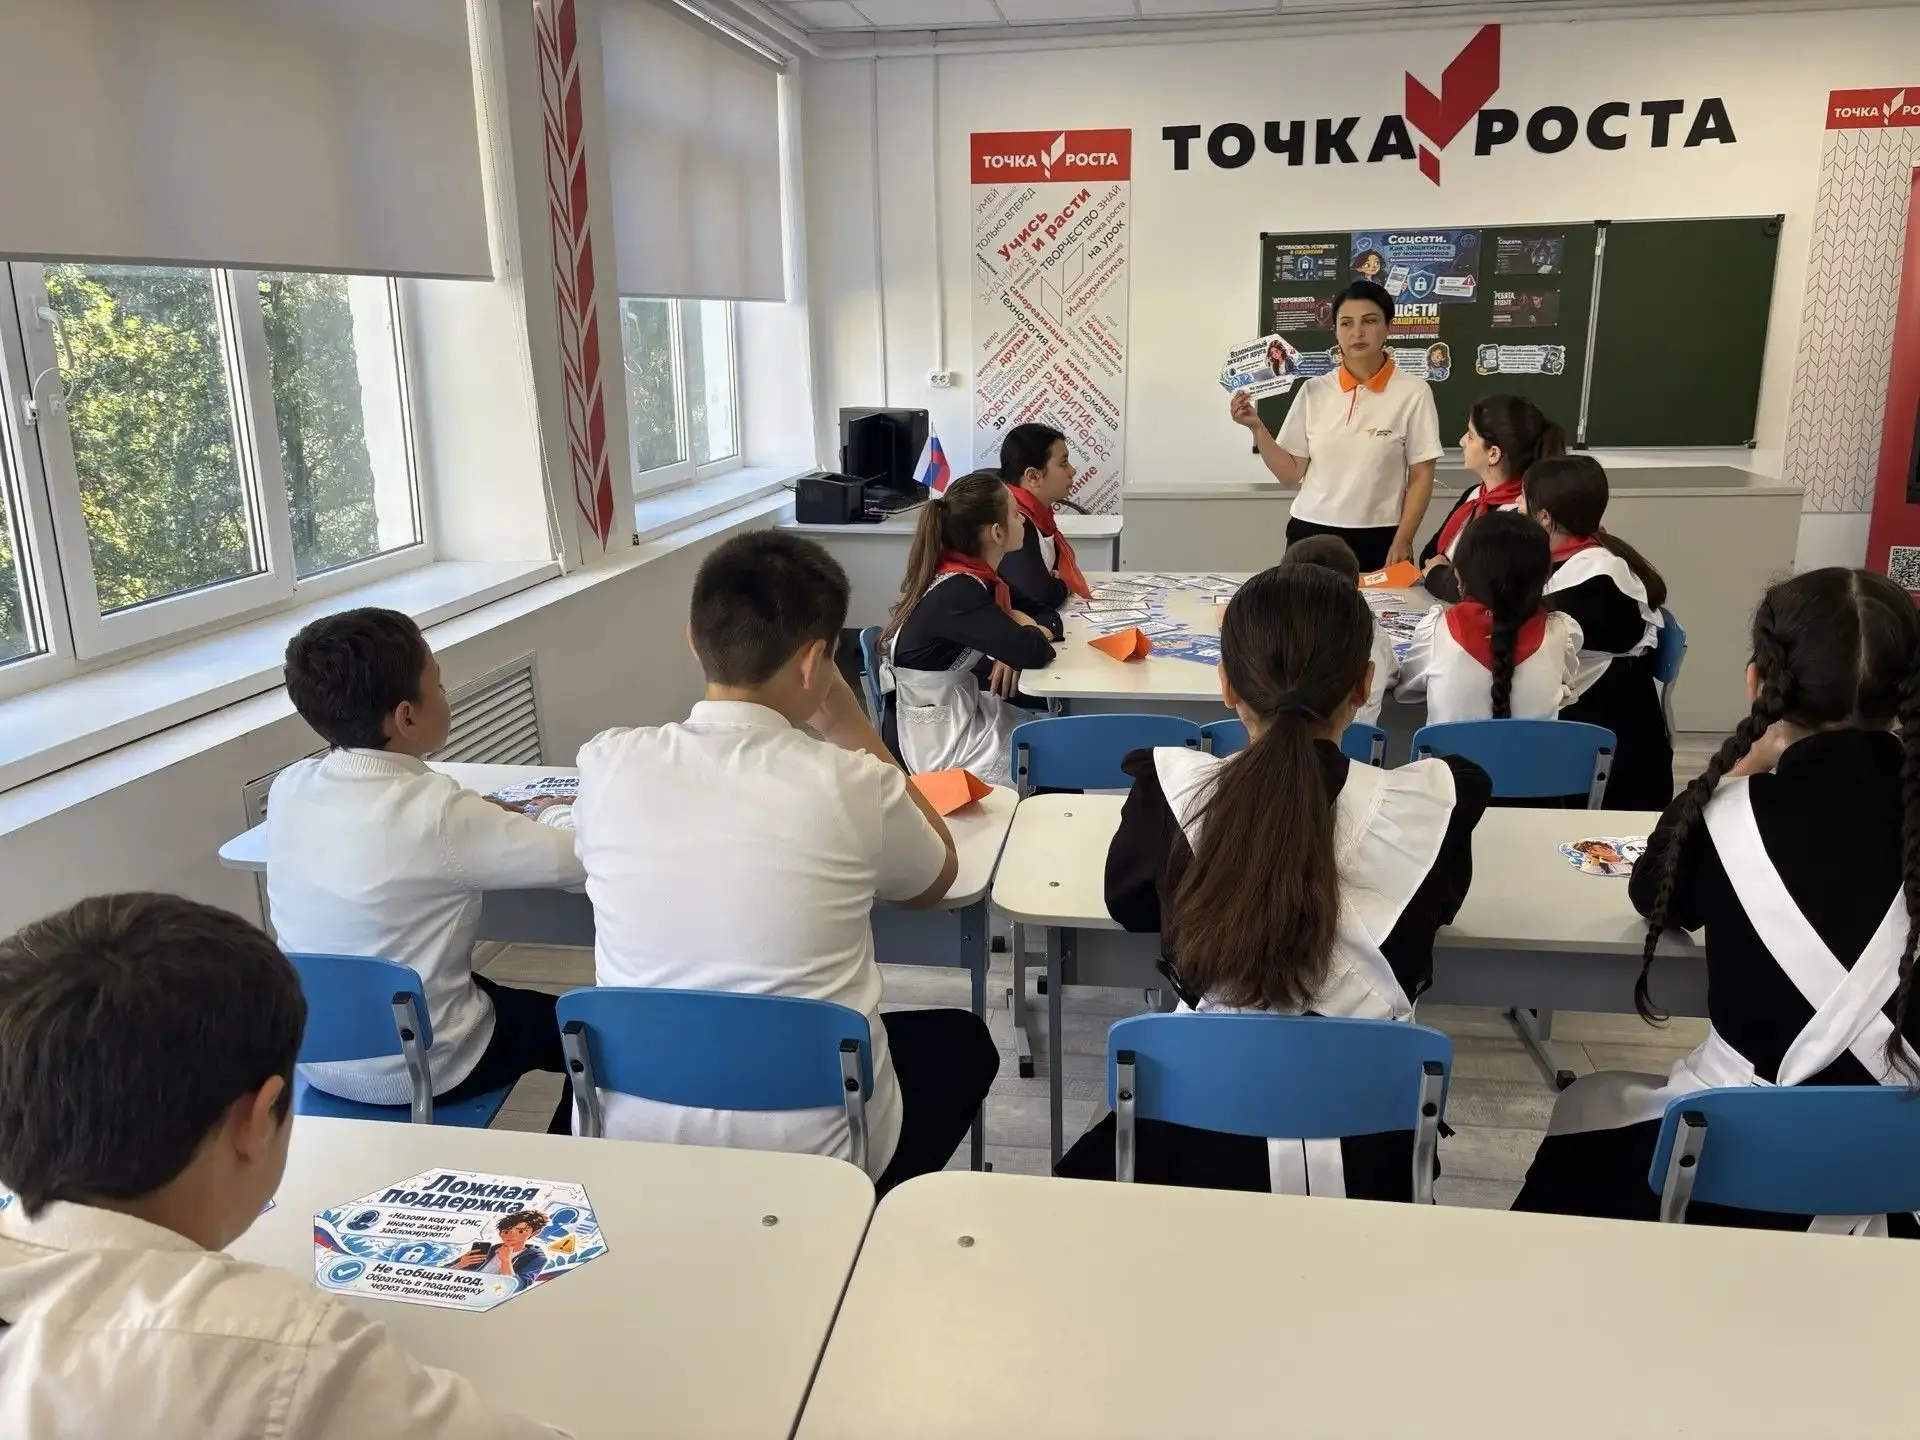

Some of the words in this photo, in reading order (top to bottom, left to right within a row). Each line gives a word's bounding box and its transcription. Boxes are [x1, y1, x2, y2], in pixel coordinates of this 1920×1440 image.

[1834, 107, 1879, 117] ТОЧКА
[1902, 105, 1920, 115] РО
[1162, 115, 1417, 171] ТОЧКА
[1474, 97, 1737, 156] РОСТА
[983, 155, 1037, 168] ТОЧКА
[1065, 153, 1118, 166] РОСТА
[976, 188, 999, 214] УМЕЙ
[976, 218, 1007, 251] ТОЛЬКО
[1005, 187, 1036, 221] ВПЕРЕД
[998, 211, 1049, 261] Учись
[1031, 237, 1046, 252] и
[1045, 188, 1092, 239] расти
[1040, 209, 1099, 270] ТВОРЧЕСТВО
[1097, 184, 1121, 212] ЗНАЙ
[1087, 221, 1107, 242] точка
[1105, 201, 1126, 224] роста
[1021, 248, 1037, 266] труд
[1088, 244, 1102, 259] на
[1100, 220, 1125, 250] урок
[1388, 235, 1447, 244] Соцсети.
[978, 256, 1024, 306] ЗНАНИЯ
[1065, 257, 1125, 317] Информатика
[1000, 291, 1049, 346] Технология
[1010, 285, 1069, 348] самореализация
[1394, 304, 1437, 317] ЦСЕТИ
[998, 332, 1031, 367] друзья
[977, 346, 1059, 429] ПРОЕКТИРОВАНИЕ
[1043, 371, 1097, 429] РАЗВИТИЕ
[1052, 363, 1079, 392] цифра
[1079, 389, 1119, 432] команда
[1065, 358, 1120, 417] компетентность
[993, 416, 1007, 431] 3D
[378, 1188, 525, 1214] поддержка
[421, 1173, 541, 1201] Ложная
[388, 1212, 427, 1223] «Назови
[428, 1216, 445, 1224] код
[460, 1218, 482, 1227] СМС,
[417, 1222, 456, 1232] аккаунт
[365, 1273, 412, 1285] Обратись
[423, 1281, 485, 1295] поддержку
[371, 1283, 398, 1291] через
[400, 1287, 466, 1300] приложение.
[372, 1264, 393, 1273] Не
[395, 1268, 454, 1281] собщай
[453, 1275, 483, 1286] код.
